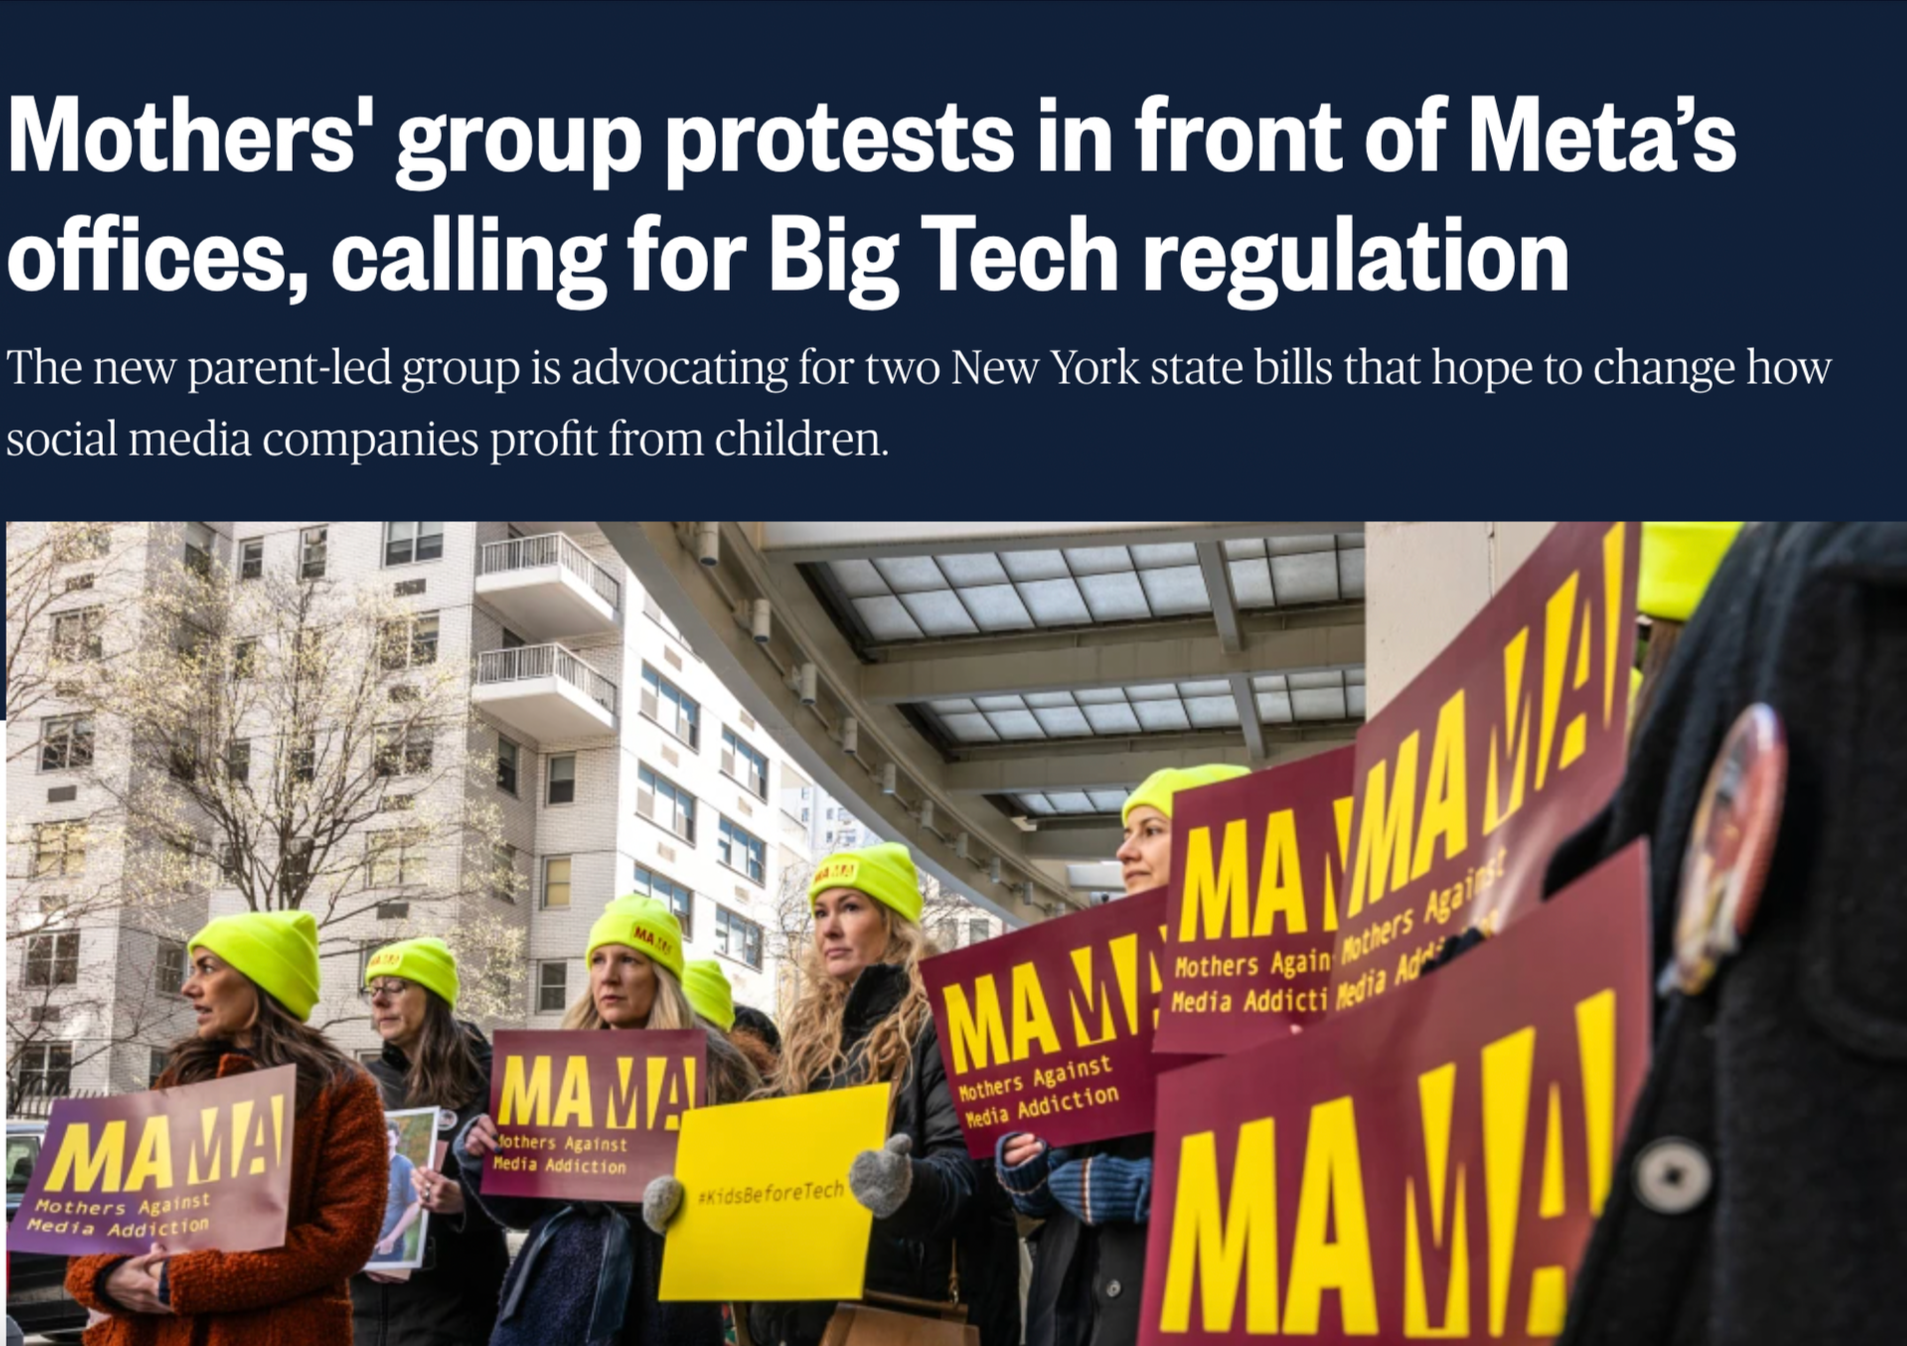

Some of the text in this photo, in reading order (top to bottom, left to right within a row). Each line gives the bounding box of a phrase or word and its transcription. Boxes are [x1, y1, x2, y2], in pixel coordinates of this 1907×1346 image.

[1341, 846, 1506, 966] Mothers Against
[1175, 948, 1331, 980] Mothers Again
[1171, 986, 1328, 1013] Media Addicti
[1335, 969, 1387, 1012] Media
[958, 1054, 1113, 1102] Mothers Against
[965, 1086, 1119, 1129] Media Addiction
[565, 1136, 628, 1154] Against
[493, 1156, 627, 1175] Media Addiction
[35, 1194, 210, 1217] Mothers Against
[698, 1179, 845, 1206] #KidsBeforeTech
[27, 1218, 209, 1238] Media Addiction
